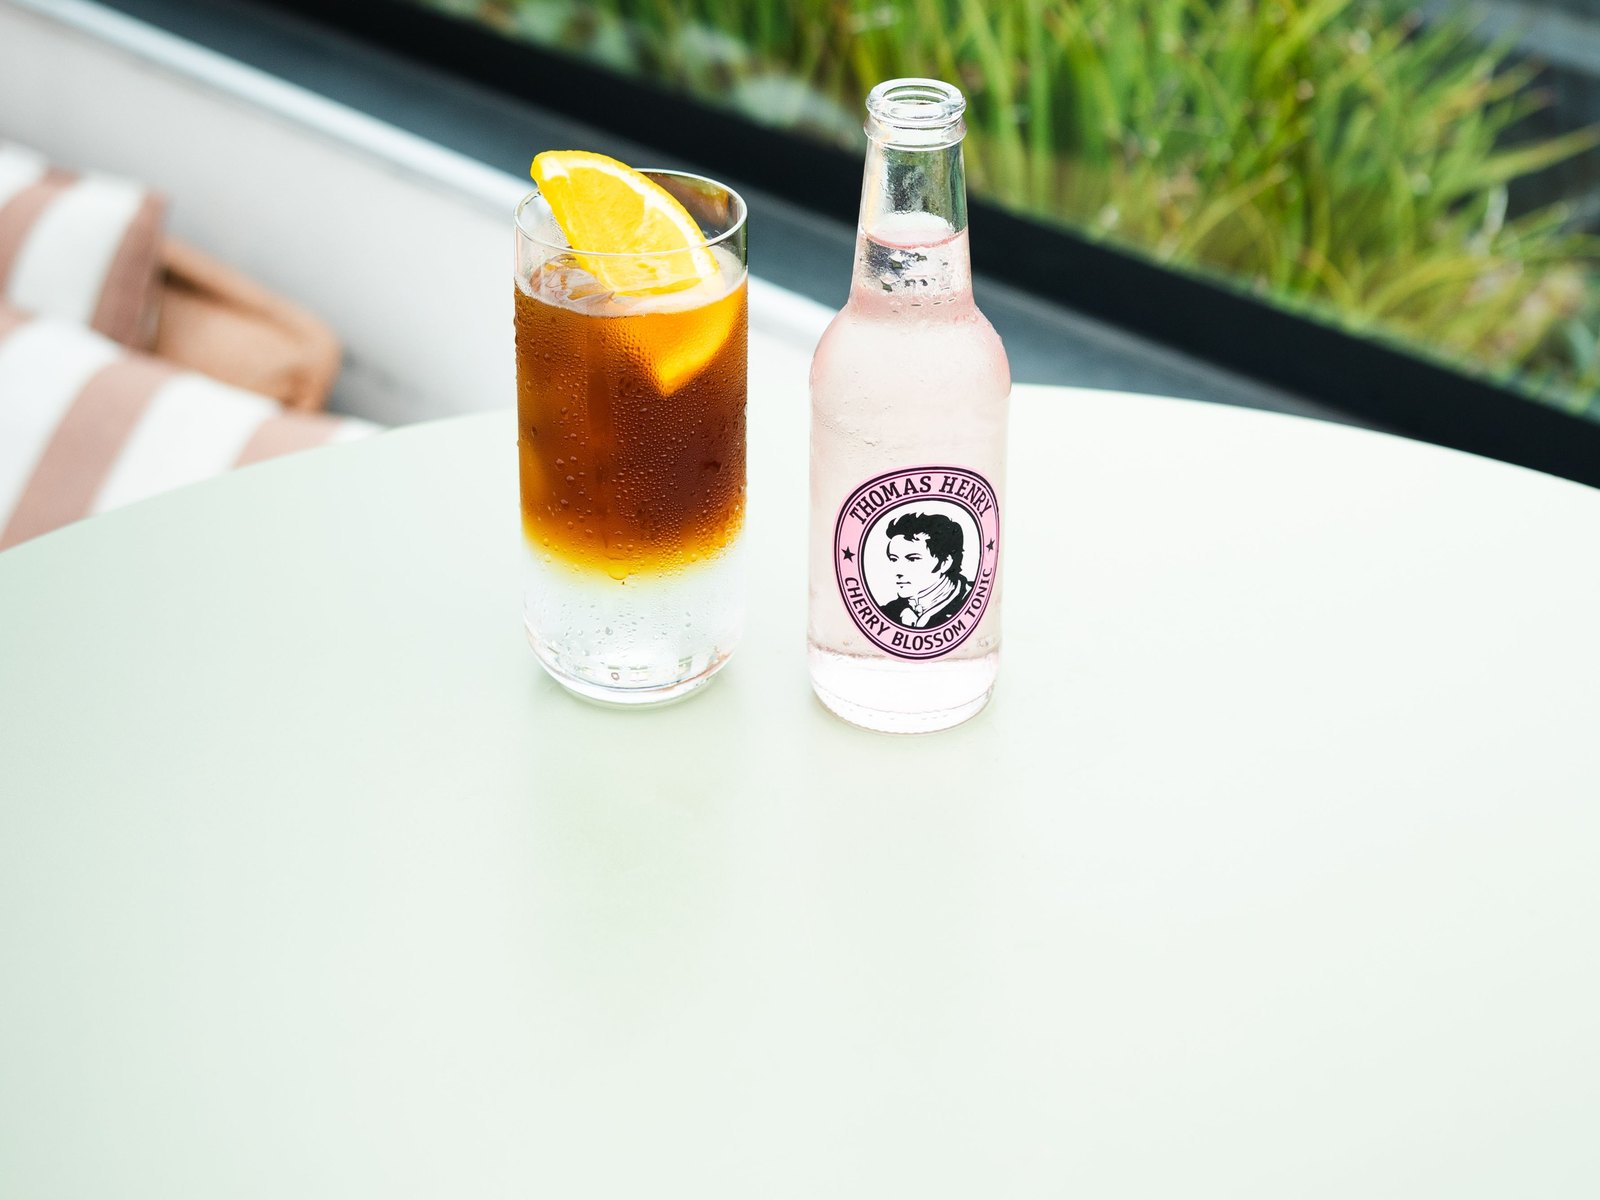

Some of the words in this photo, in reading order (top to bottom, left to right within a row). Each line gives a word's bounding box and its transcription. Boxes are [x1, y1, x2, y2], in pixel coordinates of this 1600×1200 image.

[849, 475, 932, 525] THOMAS
[939, 475, 992, 517] HENRY
[845, 576, 891, 637] CHERRY
[891, 619, 967, 650] BLOSSOM
[965, 567, 993, 620] TONIC
